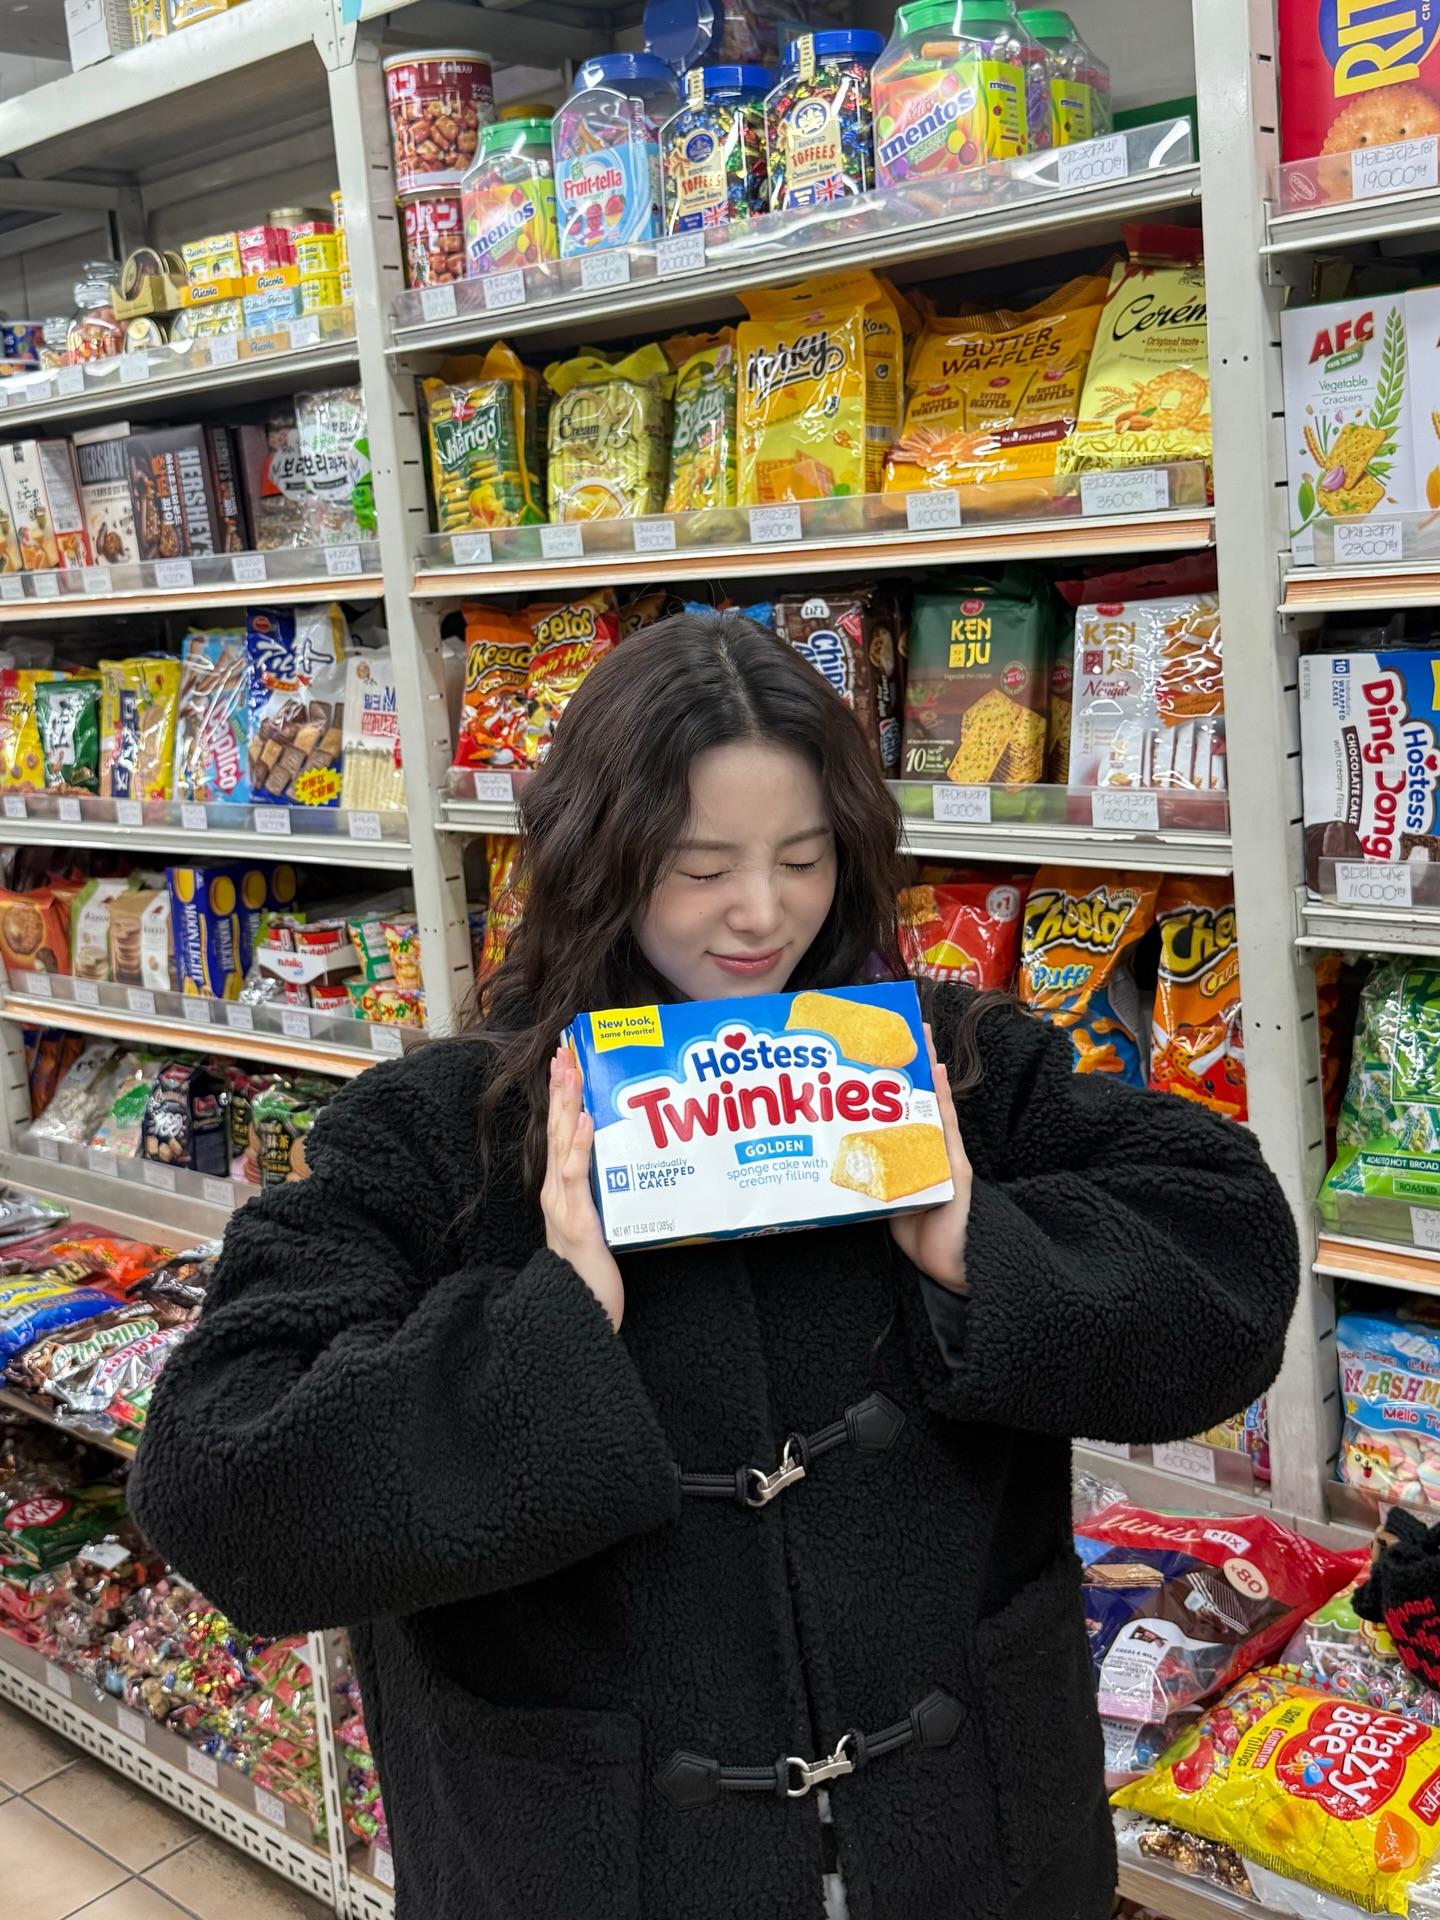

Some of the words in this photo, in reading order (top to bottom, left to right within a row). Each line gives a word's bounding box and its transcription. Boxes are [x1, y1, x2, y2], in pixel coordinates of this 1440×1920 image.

[880, 88, 973, 163] mentos
[790, 144, 836, 168] TOFFEES
[563, 169, 622, 200] Fruit-tella
[471, 201, 535, 258] mentos
[192, 287, 218, 299] Ricola
[257, 277, 285, 290] Ricola
[962, 327, 1053, 358] BUTTER
[1308, 311, 1374, 365] AFC
[941, 338, 1061, 377] WAFFLES
[1319, 375, 1368, 393] Vegetable
[1026, 389, 1075, 404] WAFFLES
[1322, 395, 1363, 406] Crackers
[559, 416, 600, 441] Cream
[446, 420, 497, 464] Mango
[951, 617, 992, 641] KEN
[1085, 621, 1136, 646] KEN
[965, 642, 991, 668] JU
[1335, 660, 1347, 673] 10
[1082, 680, 1131, 699] Nougat
[1331, 680, 1340, 707] CAKES
[1338, 679, 1346, 721] WRAPPED
[1361, 678, 1399, 764] Ding
[1333, 738, 1341, 757] with
[905, 747, 927, 773] 10
[1345, 732, 1360, 794] CHOCOLATE
[1333, 758, 1343, 789] creamy
[1403, 728, 1430, 832] Hostess
[1333, 790, 1343, 818] filling
[1348, 795, 1358, 825] CAKE
[185, 903, 205, 984] MOONLIGHT
[1032, 965, 1093, 989] Puffs
[598, 1018, 623, 1029] New
[625, 1015, 655, 1027] look,
[600, 1030, 621, 1039] same
[622, 1027, 655, 1038] favorite!
[691, 1040, 829, 1083] Hostess
[627, 1071, 904, 1150] Twinkies
[744, 1139, 805, 1158] GOLDEN
[636, 1157, 688, 1171] Individually
[637, 1165, 696, 1181] WRAPPED
[727, 1165, 769, 1181] sponge
[772, 1159, 801, 1171] cake
[802, 1157, 829, 1169] with
[1390, 1158, 1407, 1167] HOT
[1409, 1160, 1440, 1171] BROAD
[608, 1170, 628, 1188] 10
[638, 1177, 677, 1190] CAKES
[739, 1175, 783, 1190] creamy
[785, 1169, 820, 1183] filling
[1399, 1182, 1438, 1194] ROASTED
[612, 1227, 623, 1237] NET
[623, 1226, 632, 1236] WT
[648, 1222, 657, 1233] OZ
[656, 1219, 676, 1233] (385g)
[1383, 1406, 1419, 1423] Mello
[1211, 1531, 1242, 1549] Mix
[1309, 1706, 1372, 1754] Bee
[1328, 1716, 1418, 1807] Crazy
